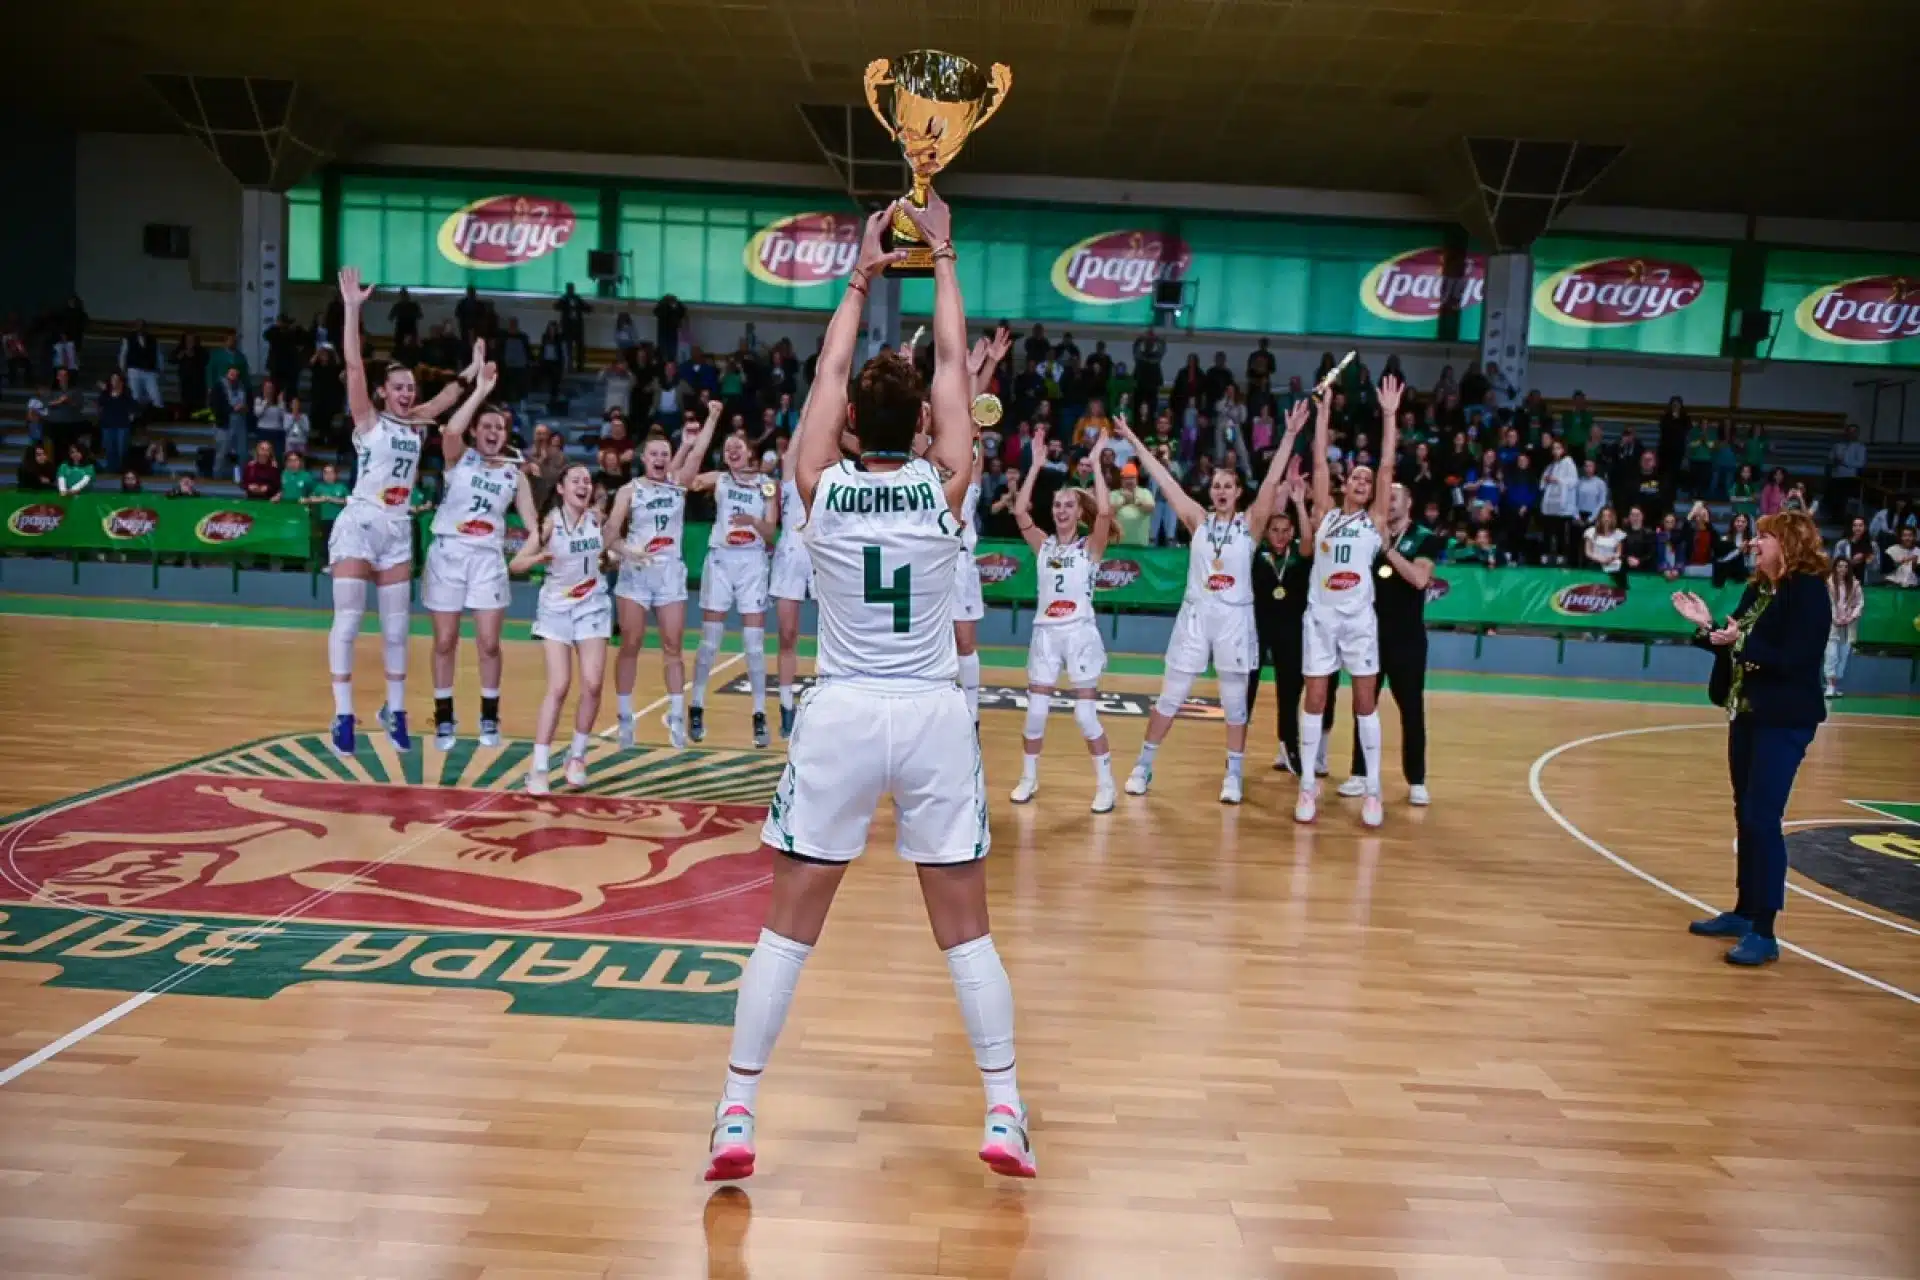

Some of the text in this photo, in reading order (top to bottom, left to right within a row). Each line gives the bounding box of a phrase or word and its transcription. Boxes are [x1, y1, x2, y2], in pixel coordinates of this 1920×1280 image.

[760, 231, 858, 275] Граду
[1553, 274, 1696, 318] Градус
[391, 457, 413, 479] 27
[469, 496, 493, 513] 34
[826, 482, 935, 513] KOCHEVA
[654, 514, 669, 531] 19
[1334, 544, 1351, 563] 10
[863, 546, 911, 633] 4
[1055, 574, 1065, 593] 2
